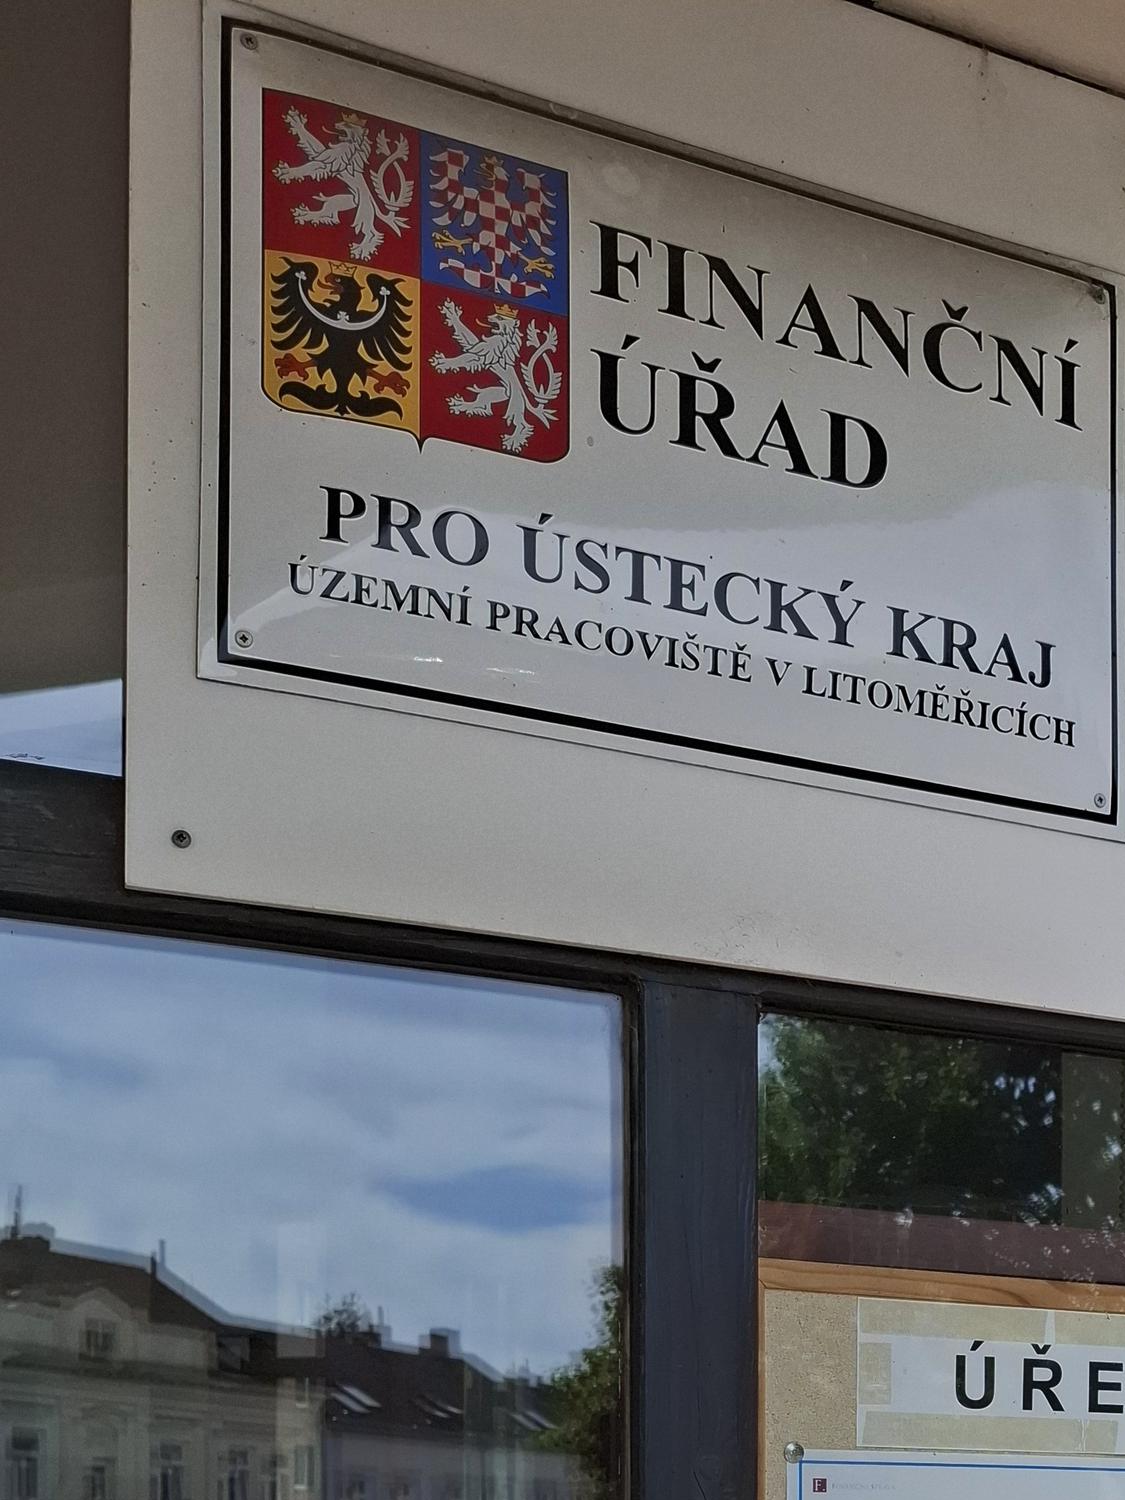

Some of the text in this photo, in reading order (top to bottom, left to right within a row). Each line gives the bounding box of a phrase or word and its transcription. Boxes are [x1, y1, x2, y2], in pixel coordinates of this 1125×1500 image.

[590, 219, 1083, 431] FINANČNÍ
[592, 333, 889, 491] ÚŘAD
[288, 554, 1076, 747] ÚZEMNÍ PRACOVIŠTĚ V LITOMĚŘICÍCH
[319, 485, 1055, 690] PRO ÚSTECKÝ KRAJ
